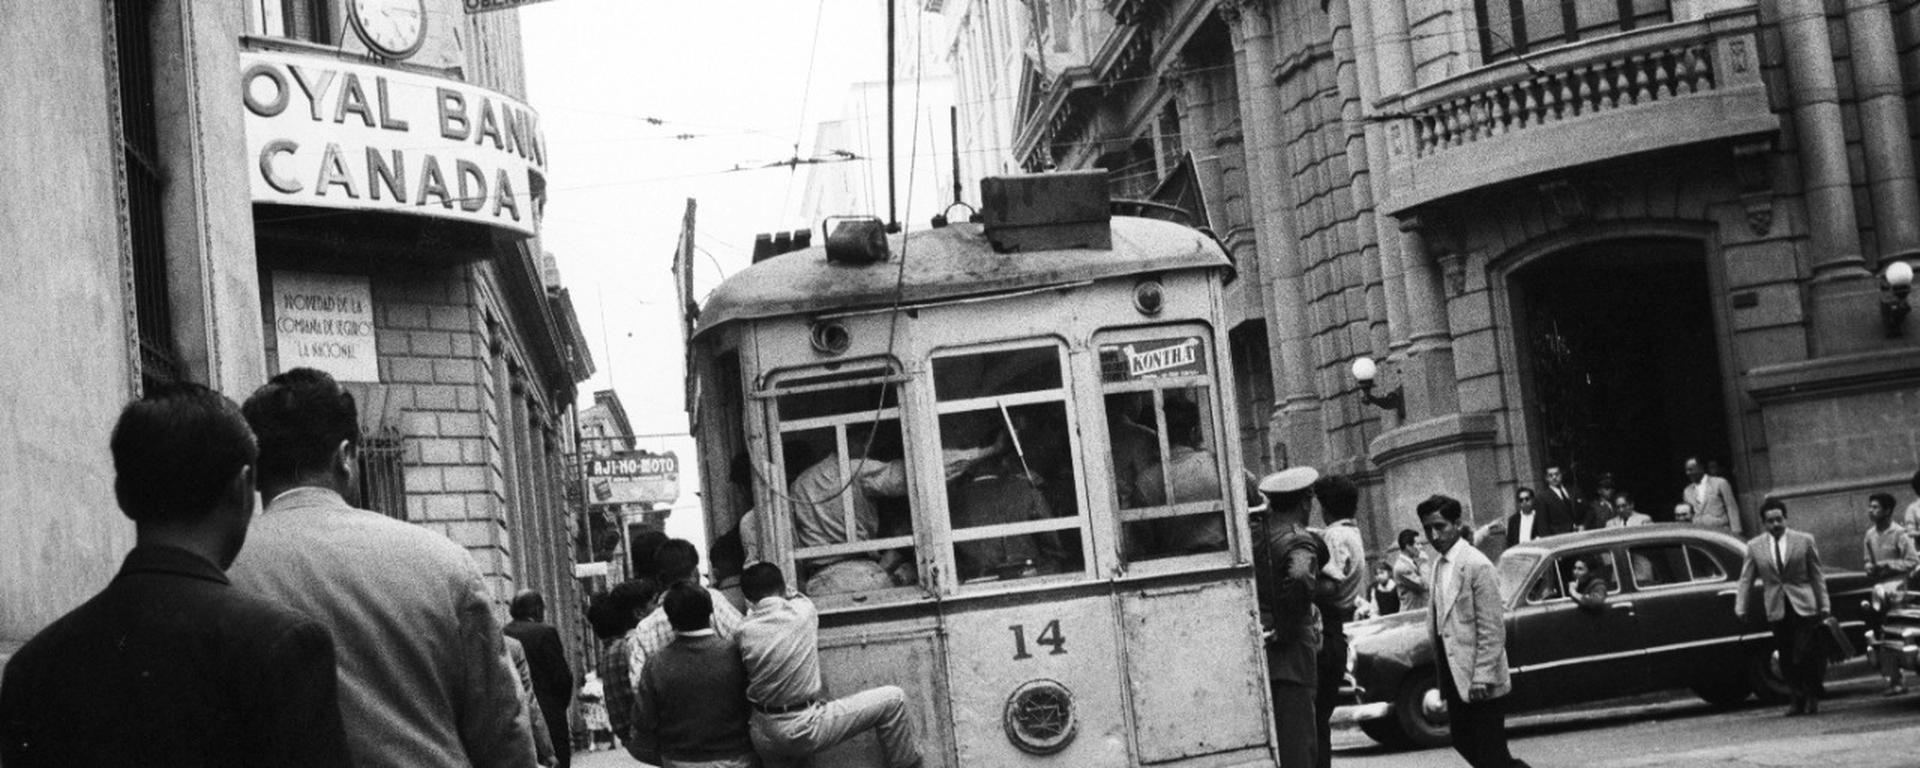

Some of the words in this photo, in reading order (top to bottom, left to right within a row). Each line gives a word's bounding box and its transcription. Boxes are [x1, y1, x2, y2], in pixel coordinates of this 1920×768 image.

[242, 63, 409, 132] OYAL
[436, 86, 543, 167] BANK
[259, 139, 520, 222] CANADA
[1008, 619, 1068, 661] 14
